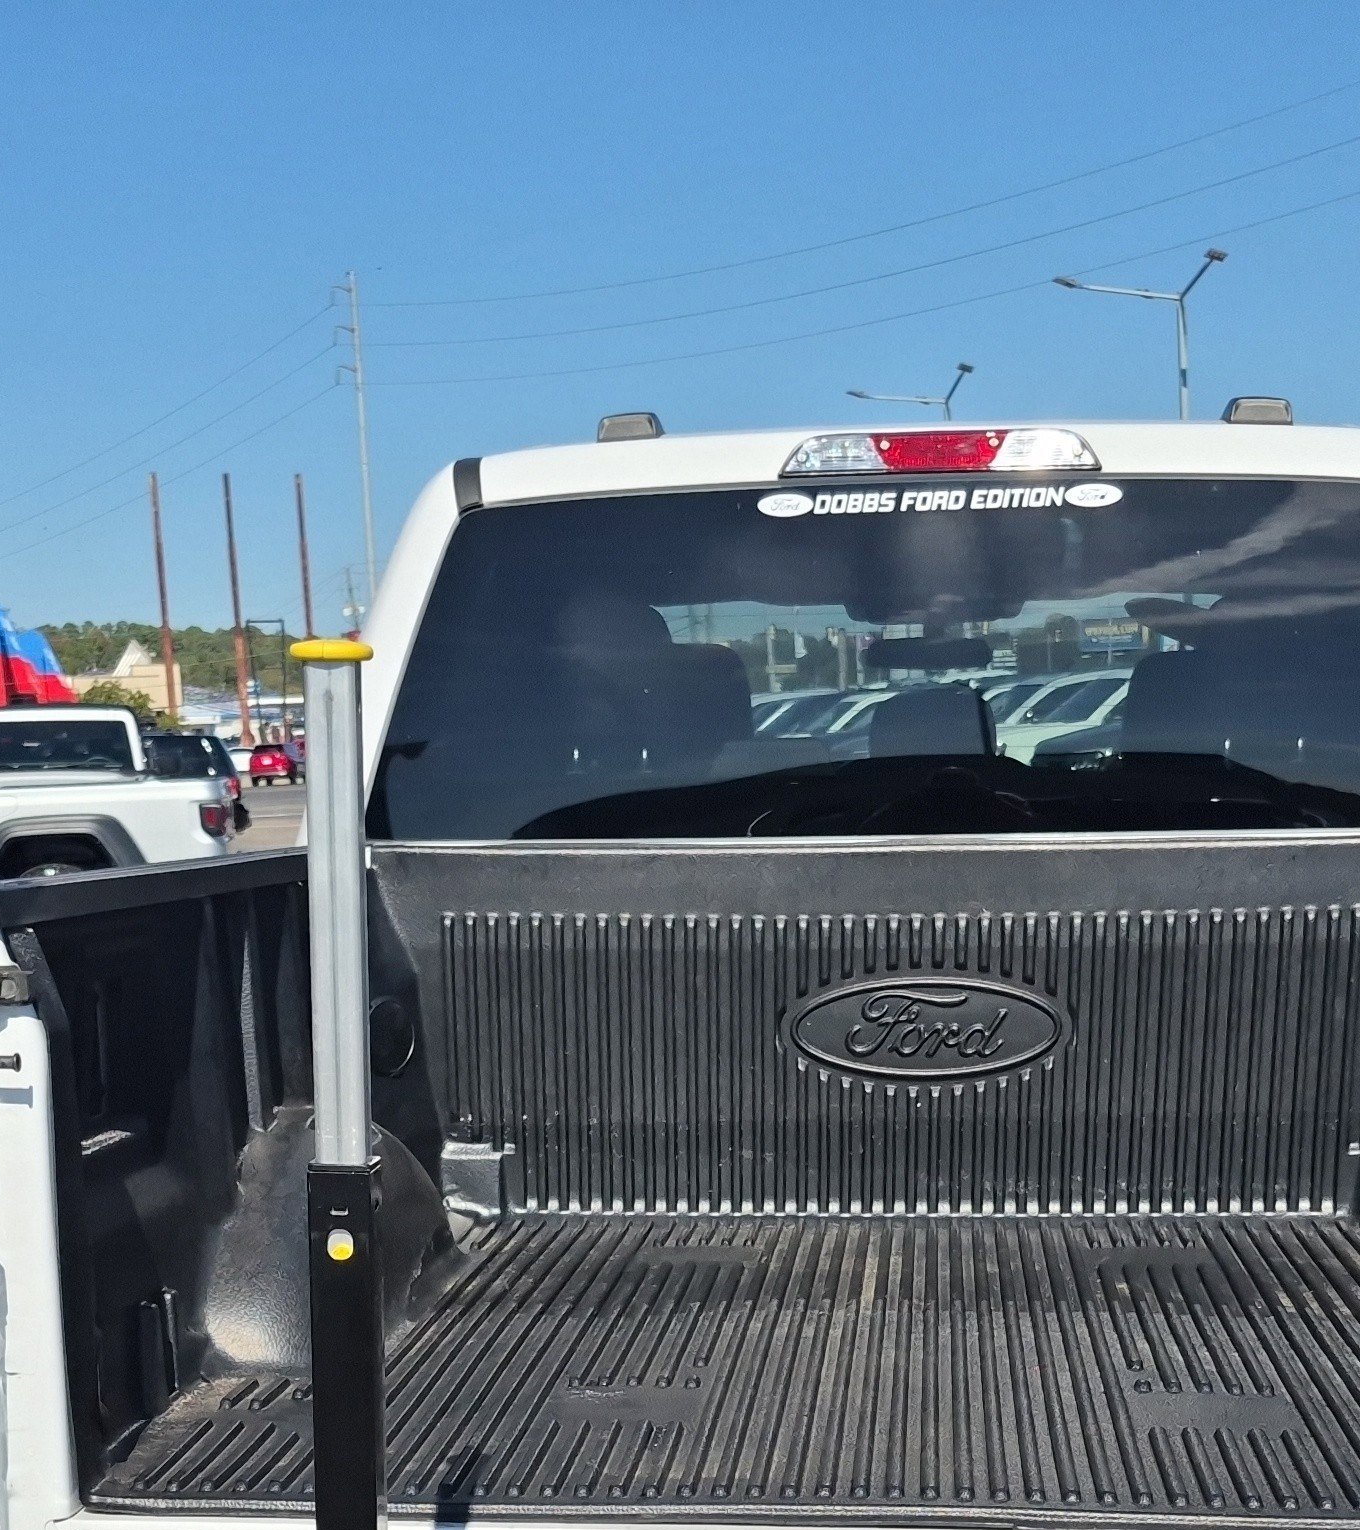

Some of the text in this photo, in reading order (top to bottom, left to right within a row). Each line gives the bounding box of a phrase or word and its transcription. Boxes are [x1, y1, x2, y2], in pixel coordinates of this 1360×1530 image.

[813, 487, 1065, 514] DOBBS FORD EDITION
[1077, 488, 1107, 501] Ford
[770, 498, 800, 512] Ford
[846, 990, 1008, 1057] Ford
